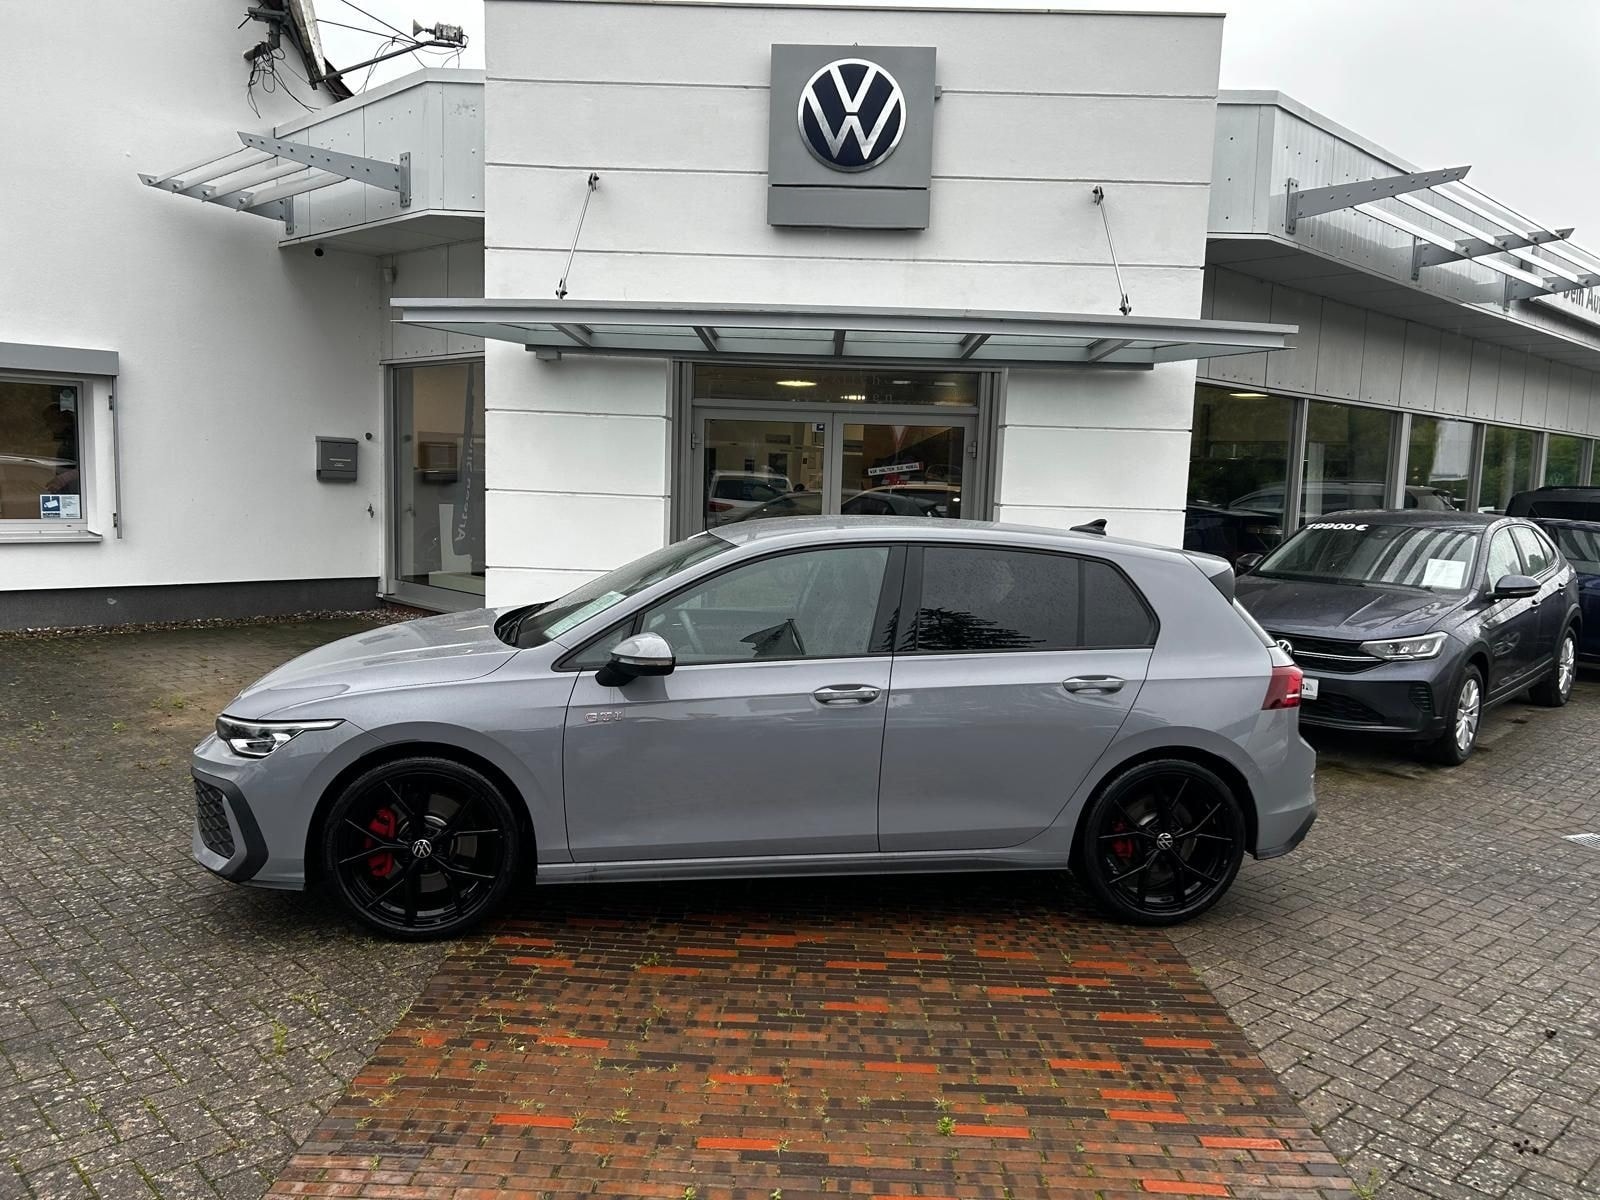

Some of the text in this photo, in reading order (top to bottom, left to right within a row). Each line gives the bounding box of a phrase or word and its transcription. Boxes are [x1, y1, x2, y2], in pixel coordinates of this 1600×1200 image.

[799, 59, 905, 171] VW
[1586, 287, 1600, 313] Au
[585, 711, 622, 722] GTI
